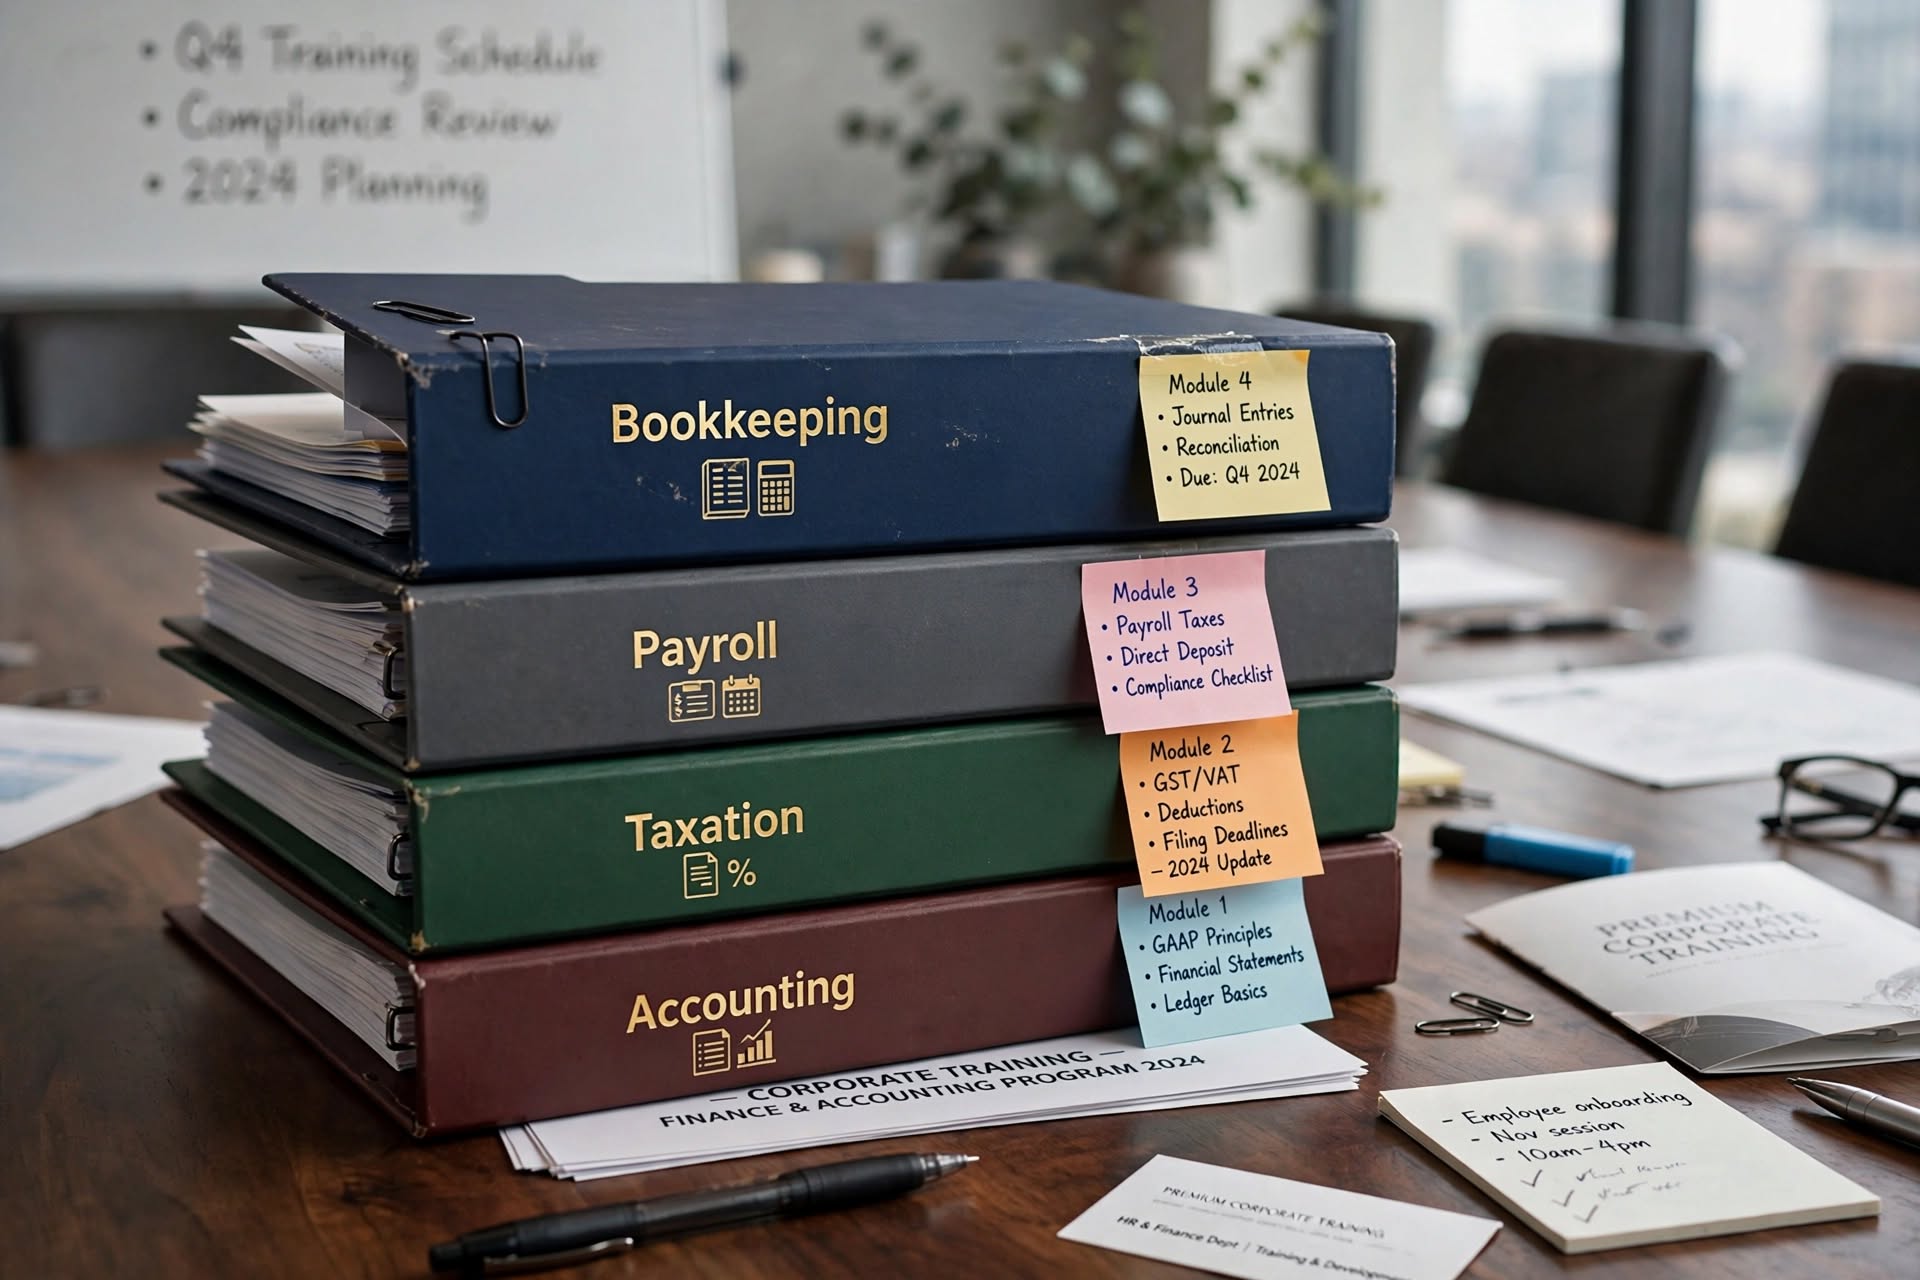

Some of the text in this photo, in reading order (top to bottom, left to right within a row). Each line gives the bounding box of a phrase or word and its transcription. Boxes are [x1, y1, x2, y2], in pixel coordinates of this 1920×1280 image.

[174, 20, 602, 94] Q4 Training Schedule
[176, 92, 560, 152] Compliance Review
[184, 157, 490, 225] 2024 Planning
[1169, 370, 1252, 394] Module 4
[611, 395, 889, 446] Bookkeeping
[1172, 402, 1295, 426] Journal Entries
[1176, 433, 1280, 456] Reconciliation
[1180, 461, 1300, 487] Due: Q4 2024
[1113, 576, 1199, 603] Module 3
[1116, 609, 1225, 641] Payroll Taxes
[633, 620, 778, 675] Payroll
[1121, 637, 1234, 667] Direct Deposit
[1125, 664, 1273, 700] Compliance Checklist
[1150, 734, 1235, 762] Module 2
[1153, 764, 1241, 792] GST/VAT
[625, 801, 804, 852] Taxation
[1158, 798, 1244, 823] Deductions
[1163, 821, 1289, 854] Filing Deadlines
[1168, 849, 1273, 878] 2024 Update
[1149, 895, 1227, 924] Module 1
[1596, 901, 1775, 938] PREMIUM
[1153, 921, 1273, 953] GAAP Principles
[1603, 911, 1821, 954] CORPORATE
[1629, 927, 1819, 965] TRAINING
[1158, 945, 1305, 983] Financial Statements
[626, 970, 855, 1034] Accounting
[1164, 984, 1268, 1016] Ledger Basics
[659, 1055, 1206, 1128] FINANCE & ACCOUNTING PROGRAM 2024
[747, 1050, 1093, 1101] CORPORATE TRAINING
[1462, 1091, 1693, 1125] Employee onboarding
[1490, 1121, 1625, 1143] Nov session
[1117, 1215, 1139, 1227] HR
[1140, 1221, 1151, 1230] &
[1153, 1223, 1204, 1242] Finance
[1206, 1235, 1239, 1249] Dept
[1256, 1245, 1307, 1265] Training
[1309, 1257, 1320, 1266] &
